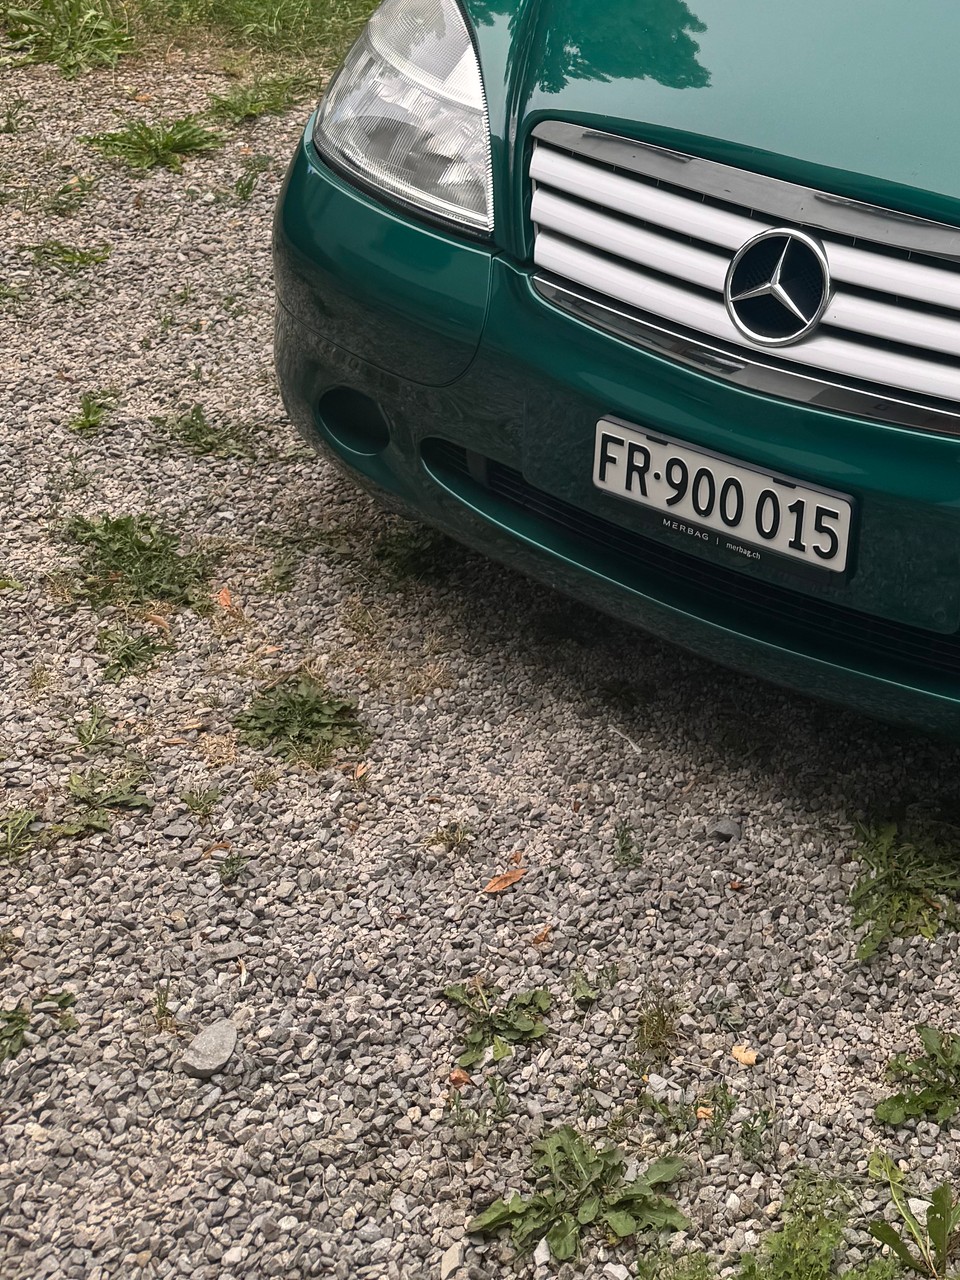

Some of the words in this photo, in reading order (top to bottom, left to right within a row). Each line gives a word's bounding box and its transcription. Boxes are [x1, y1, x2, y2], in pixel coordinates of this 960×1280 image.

[662, 518, 709, 541] MERBAG
[726, 542, 761, 560] merbag.ch
[755, 488, 839, 559] 015
